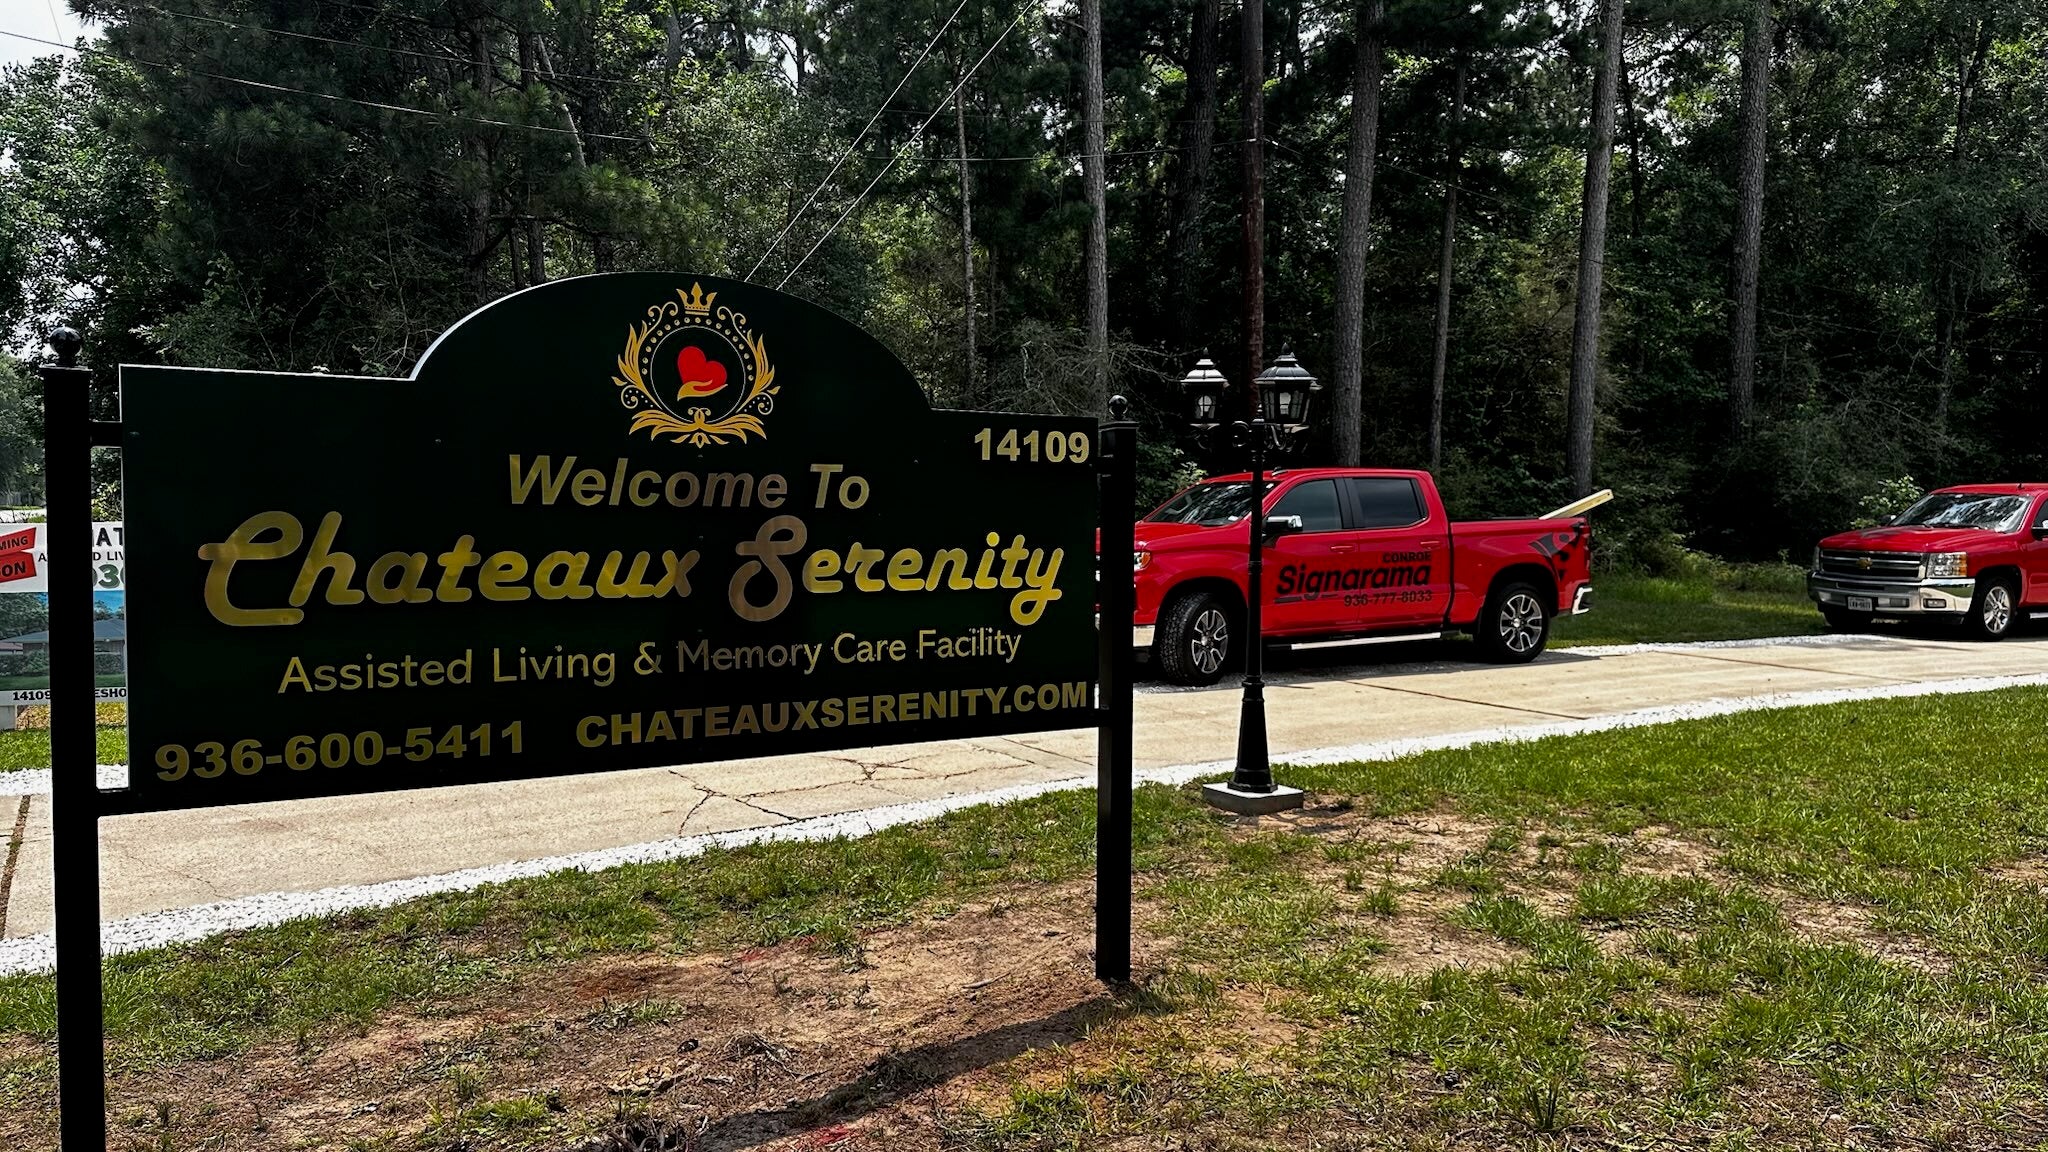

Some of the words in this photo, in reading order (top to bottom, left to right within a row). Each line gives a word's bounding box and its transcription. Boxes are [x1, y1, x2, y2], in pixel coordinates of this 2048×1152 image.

[974, 427, 1090, 464] 14109
[509, 454, 788, 508] Welcome
[809, 463, 870, 510] To
[0, 536, 28, 550] MING
[1382, 551, 1431, 563] CONROE
[198, 510, 700, 626] Chateaux
[728, 514, 1064, 626] Serenity
[1276, 562, 1432, 601] Signarama
[1344, 590, 1433, 607] 936-777-8033
[278, 648, 472, 693] Assisted
[493, 645, 616, 687] Living
[633, 641, 663, 676] &
[678, 638, 822, 675] Memory
[833, 632, 907, 663] Care
[918, 627, 1022, 664] Facility
[155, 720, 524, 781] 936-600-5411
[576, 681, 1089, 748] CHATEAUXSERENITY.COM
